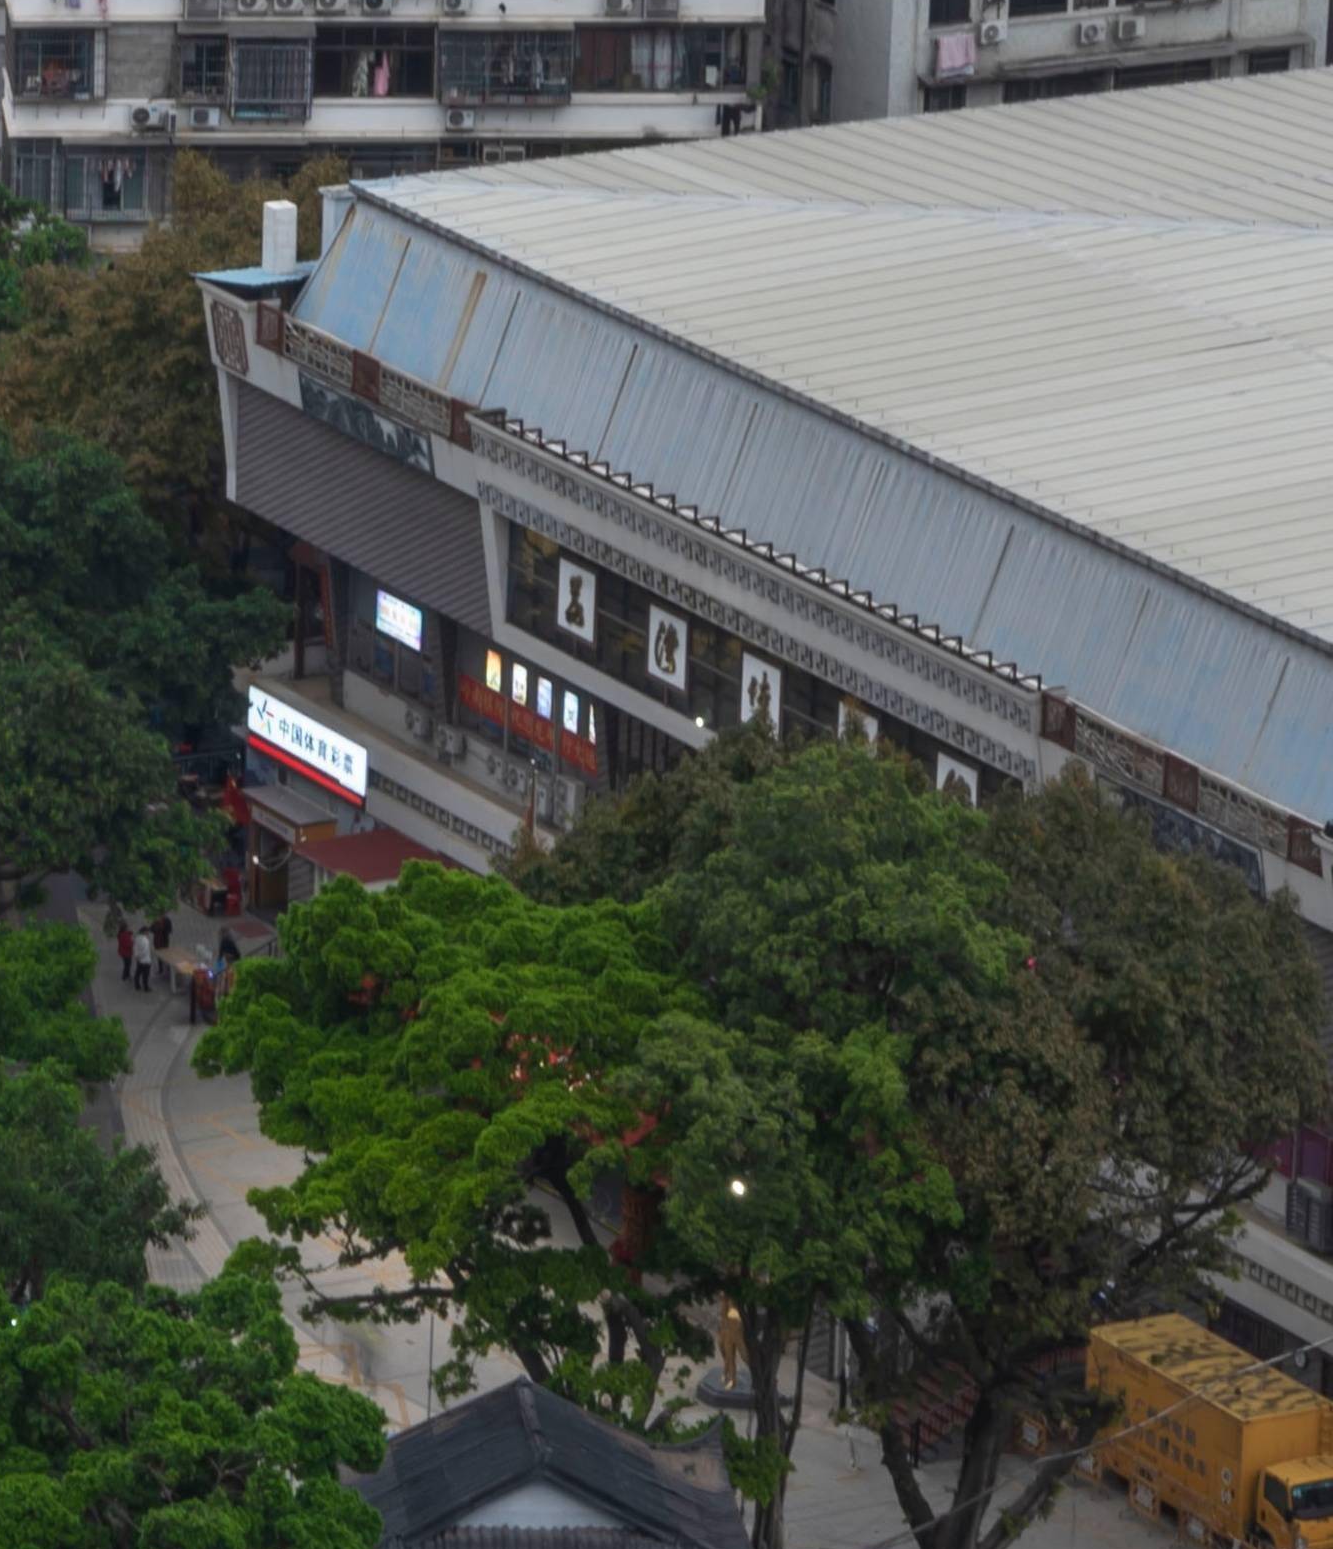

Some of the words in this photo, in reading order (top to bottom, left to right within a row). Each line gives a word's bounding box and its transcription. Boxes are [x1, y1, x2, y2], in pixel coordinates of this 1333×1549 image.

[279, 718, 354, 775] 中国体育彩票
